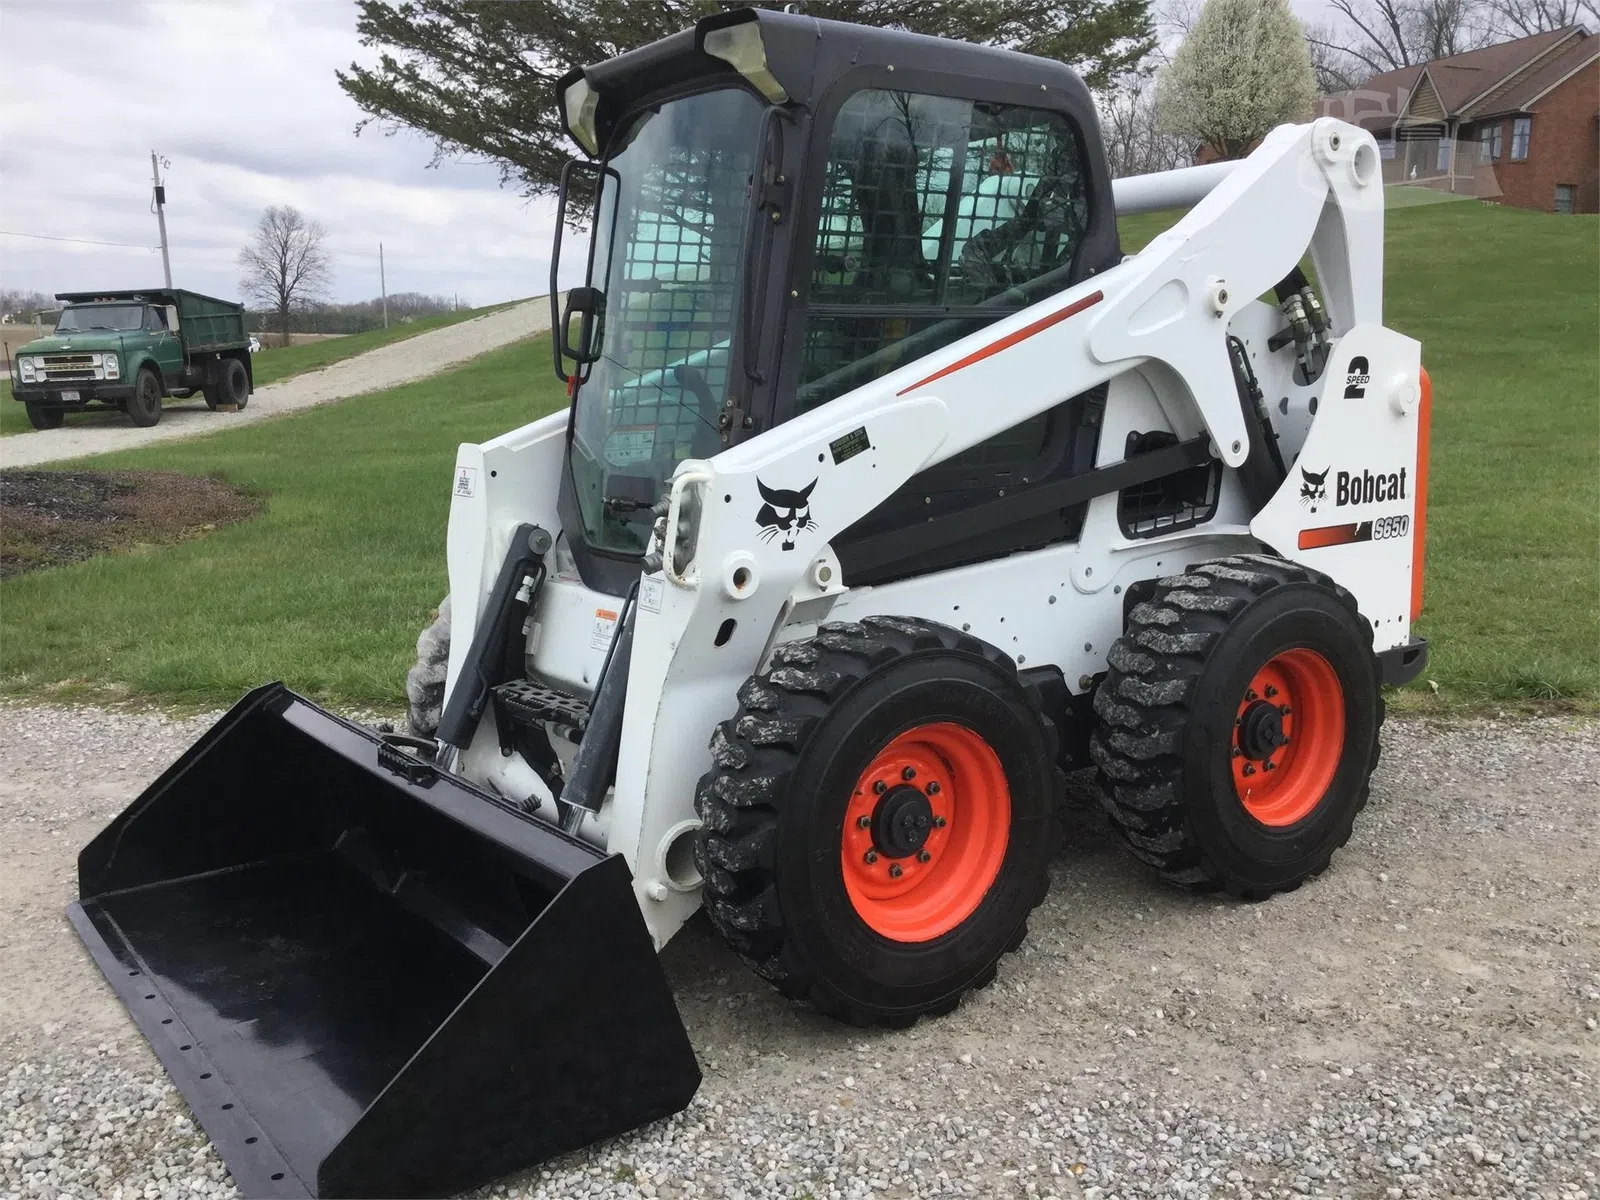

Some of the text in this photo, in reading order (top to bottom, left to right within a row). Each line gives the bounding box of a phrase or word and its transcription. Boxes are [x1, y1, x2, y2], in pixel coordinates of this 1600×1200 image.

[1344, 356, 1369, 399] 2
[1346, 375, 1371, 385] SPEED
[1336, 467, 1406, 507] Bobcat
[1374, 515, 1409, 540] S650
